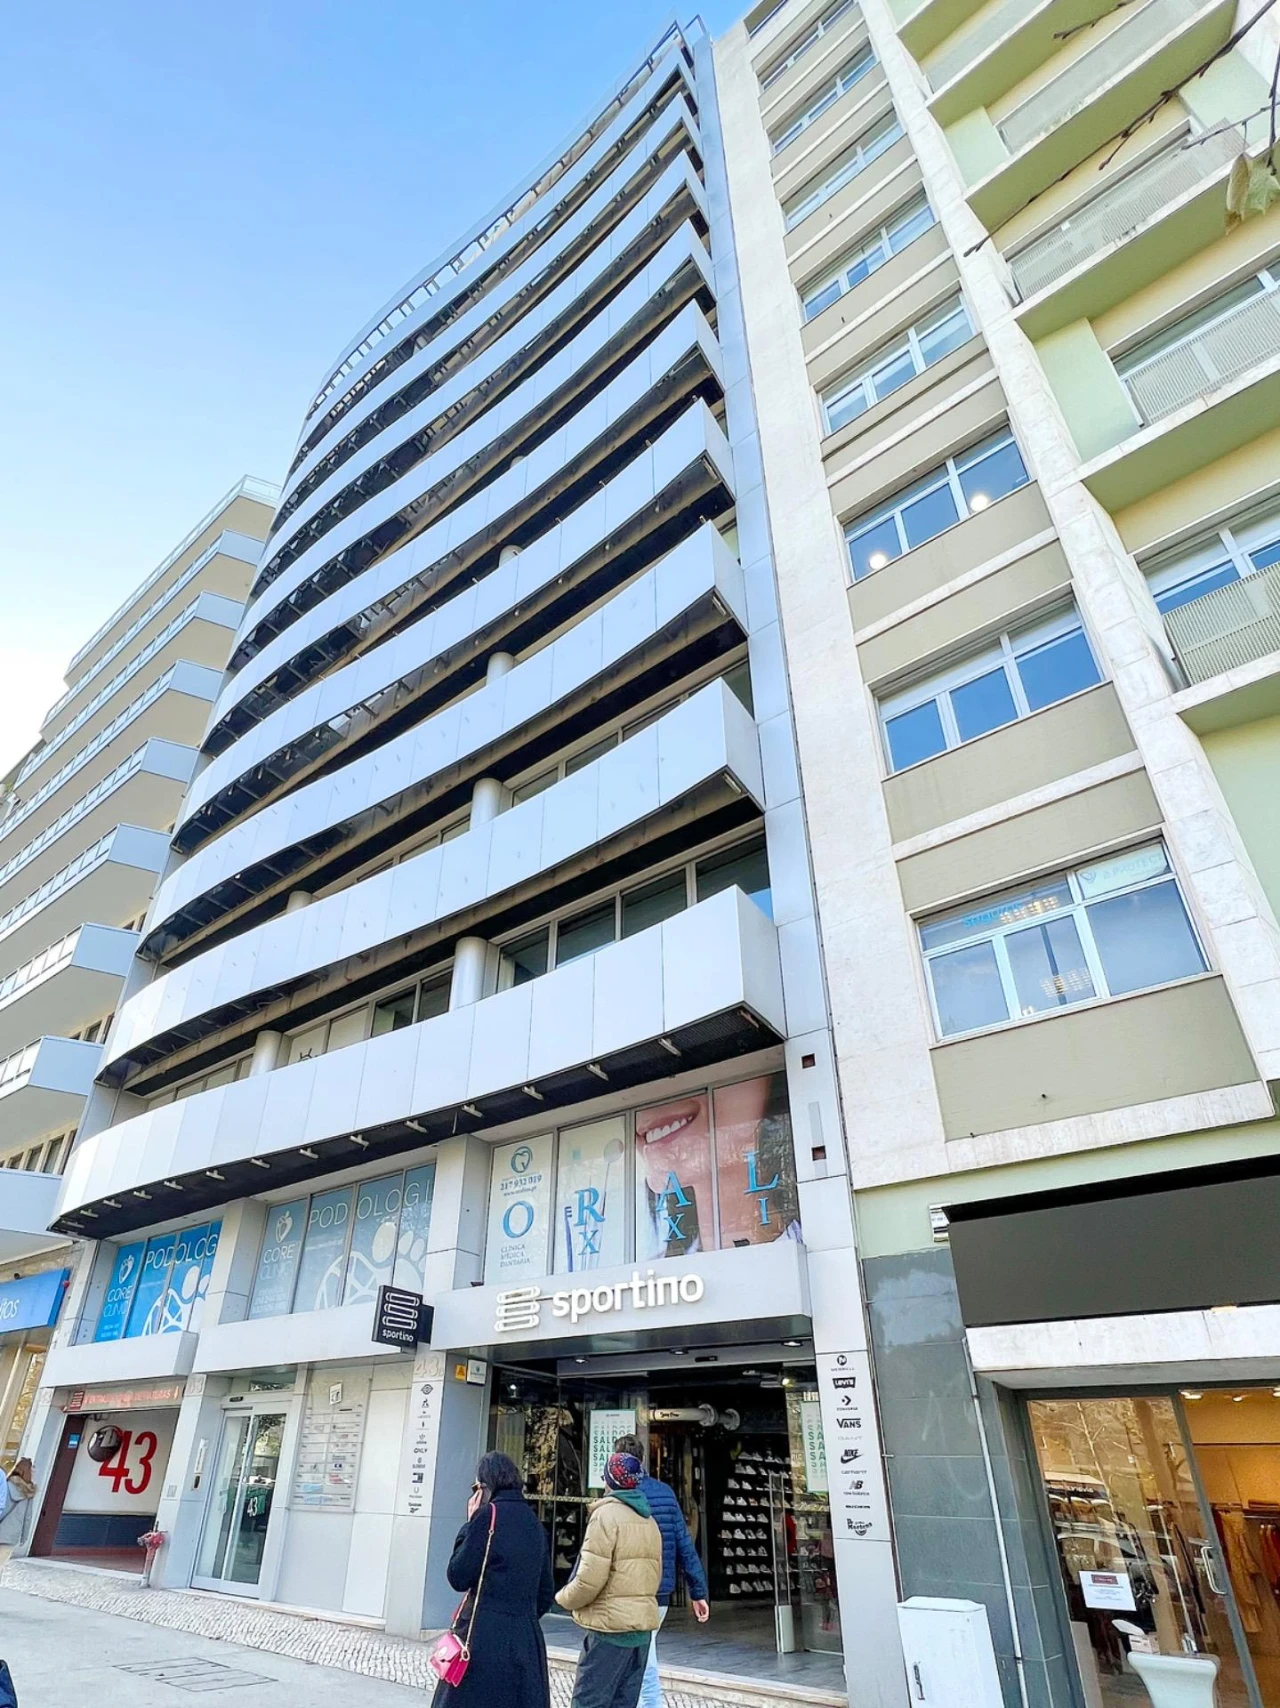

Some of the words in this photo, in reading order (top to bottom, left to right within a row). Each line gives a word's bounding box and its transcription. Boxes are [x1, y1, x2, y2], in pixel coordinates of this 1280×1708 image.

[263, 1244, 296, 1264] CORE
[107, 1285, 133, 1303] CORE
[552, 1269, 704, 1324] sportino
[382, 1328, 414, 1343] sportino
[836, 1417, 862, 1429] VANS
[98, 1430, 158, 1495] 43
